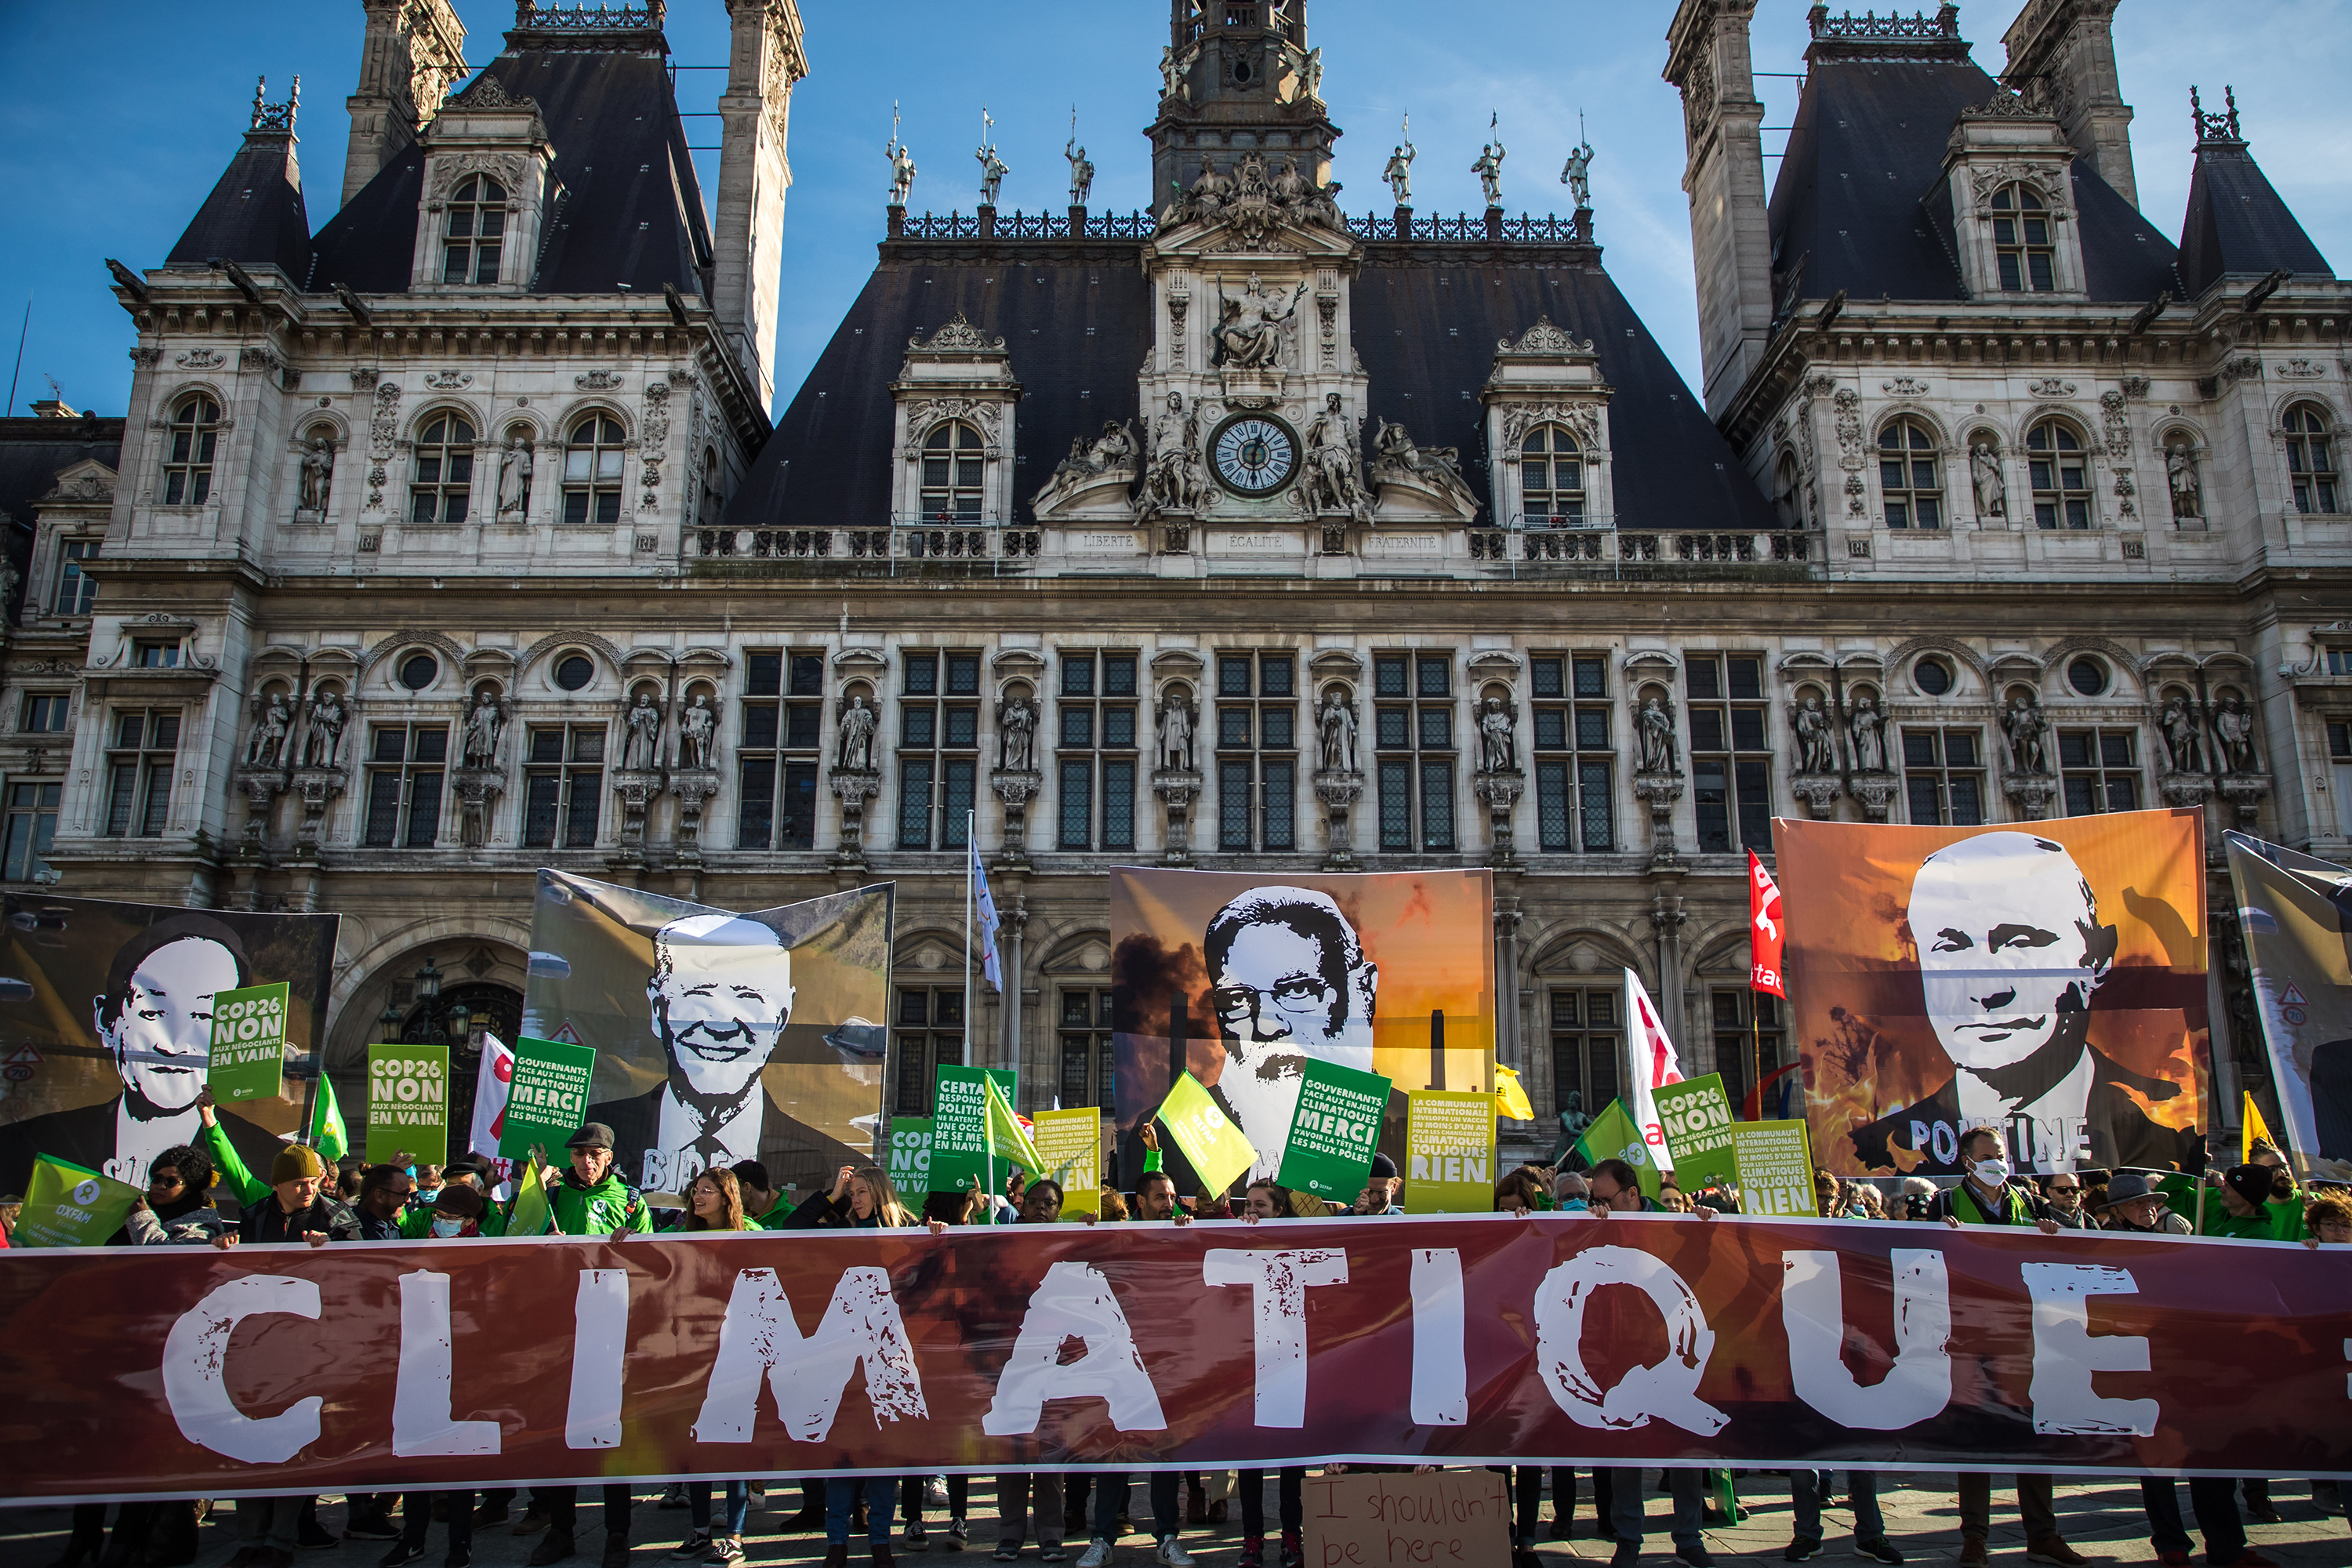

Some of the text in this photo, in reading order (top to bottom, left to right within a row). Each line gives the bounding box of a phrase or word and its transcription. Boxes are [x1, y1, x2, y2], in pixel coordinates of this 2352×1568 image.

[1083, 535, 1133, 546] LIBERTÉ
[1368, 535, 1436, 548] FRATERNITÉ
[216, 996, 283, 1021] COP26,
[2289, 1011, 2302, 1021] 70
[215, 1015, 282, 1044] NON
[231, 1037, 281, 1051] NÉGOCIANTS
[211, 1046, 281, 1067] EN VAIN.
[371, 1059, 444, 1080] COP26,
[517, 1066, 585, 1083] FACE AUX ENJEUX
[518, 1057, 589, 1076] GOUVERNANTS,
[372, 1078, 443, 1102] NON
[515, 1074, 584, 1094] CLIMATIQUES
[940, 1080, 1011, 1098] CERTAS
[512, 1084, 583, 1112] MERCI
[939, 1094, 985, 1105] RESPONS
[1304, 1089, 1379, 1114] FACE AUX ENJEUX
[1306, 1080, 1384, 1108] GOUVERNANTS,
[1658, 1087, 1724, 1115] COP26,
[391, 1102, 443, 1111] NÉGOCIANTS
[510, 1103, 537, 1112] D'AVOIR
[549, 1109, 564, 1117] TÊTE
[938, 1103, 985, 1115] POLITIQ
[1301, 1098, 1377, 1125] CLIMATIQUES
[1413, 1107, 1488, 1116] INTERNATIONALE
[1425, 1100, 1488, 1109] COMMUNAUTÉ
[370, 1112, 444, 1126] EN VAIN.
[510, 1111, 579, 1130] LES DEUX PÔLES.
[936, 1122, 985, 1132] UNE OCCA
[1046, 1115, 1093, 1125] COMMUNAUTÉ
[1297, 1109, 1375, 1145] MERCI
[1664, 1103, 1730, 1138] NON
[936, 1131, 949, 1140] DE
[951, 1131, 963, 1141] SE
[1037, 1123, 1093, 1134] INTERNATIONALE
[1192, 1114, 1217, 1145] OXFAM
[1746, 1127, 1799, 1138] COMMUNAUTÉ
[892, 1131, 932, 1148] COP
[935, 1141, 985, 1152] EN NAVR
[1294, 1128, 1323, 1141] D'AVOIR
[1336, 1138, 1353, 1149] TÊTE
[1355, 1144, 1370, 1153] SUR
[1412, 1134, 1487, 1146] CLIMATIQUES
[1670, 1137, 1686, 1145] AUX
[1737, 1137, 1801, 1147] INTERNATIONALE
[1910, 1117, 2092, 1165] POTINE
[1292, 1137, 1308, 1148] LES
[1309, 1142, 1336, 1155] DEUX
[1338, 1147, 1370, 1164] PÔLES.
[1412, 1144, 1487, 1158] TOUJOURS
[1671, 1143, 1692, 1159] EN
[640, 1145, 757, 1192] BID
[891, 1149, 930, 1171] NO
[1044, 1157, 1094, 1169] OUJOURS
[1411, 1154, 1492, 1184] RIEN.
[1041, 1168, 1098, 1192] IEN.
[1740, 1165, 1806, 1178] CLIMATIQUES
[1742, 1174, 1808, 1189] TOUJOURS
[1744, 1187, 1816, 1214] RIEN.
[56, 1204, 93, 1224] OXFAM
[162, 1244, 2160, 1465] CLIMATIQUE
[1309, 1479, 1506, 1526] I shouldn't
[1322, 1529, 1465, 1568] be here
